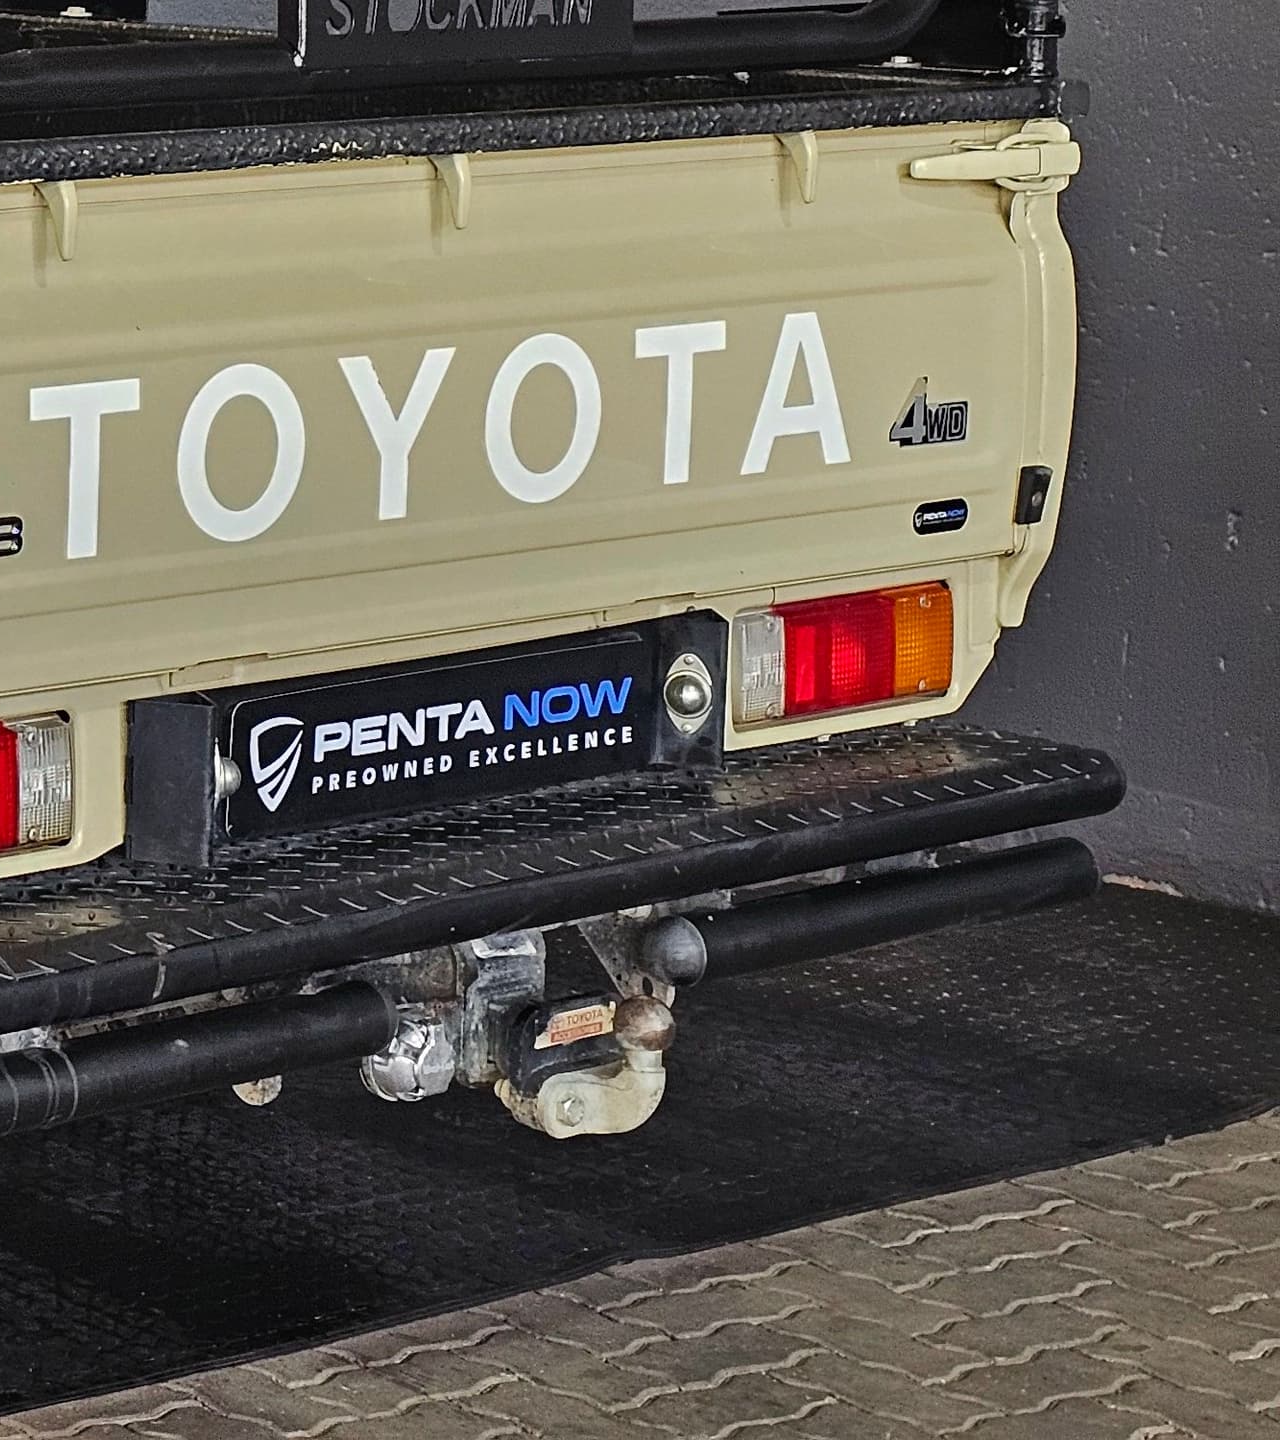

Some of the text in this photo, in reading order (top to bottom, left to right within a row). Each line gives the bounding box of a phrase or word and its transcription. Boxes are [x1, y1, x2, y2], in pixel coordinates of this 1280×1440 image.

[29, 311, 851, 559] TOYOTA
[889, 376, 968, 447] 4WD
[313, 676, 634, 763] PENTA NOW
[311, 725, 635, 794] PREOWNED EXCELLENCE
[567, 1009, 603, 1025] TOYOTA
